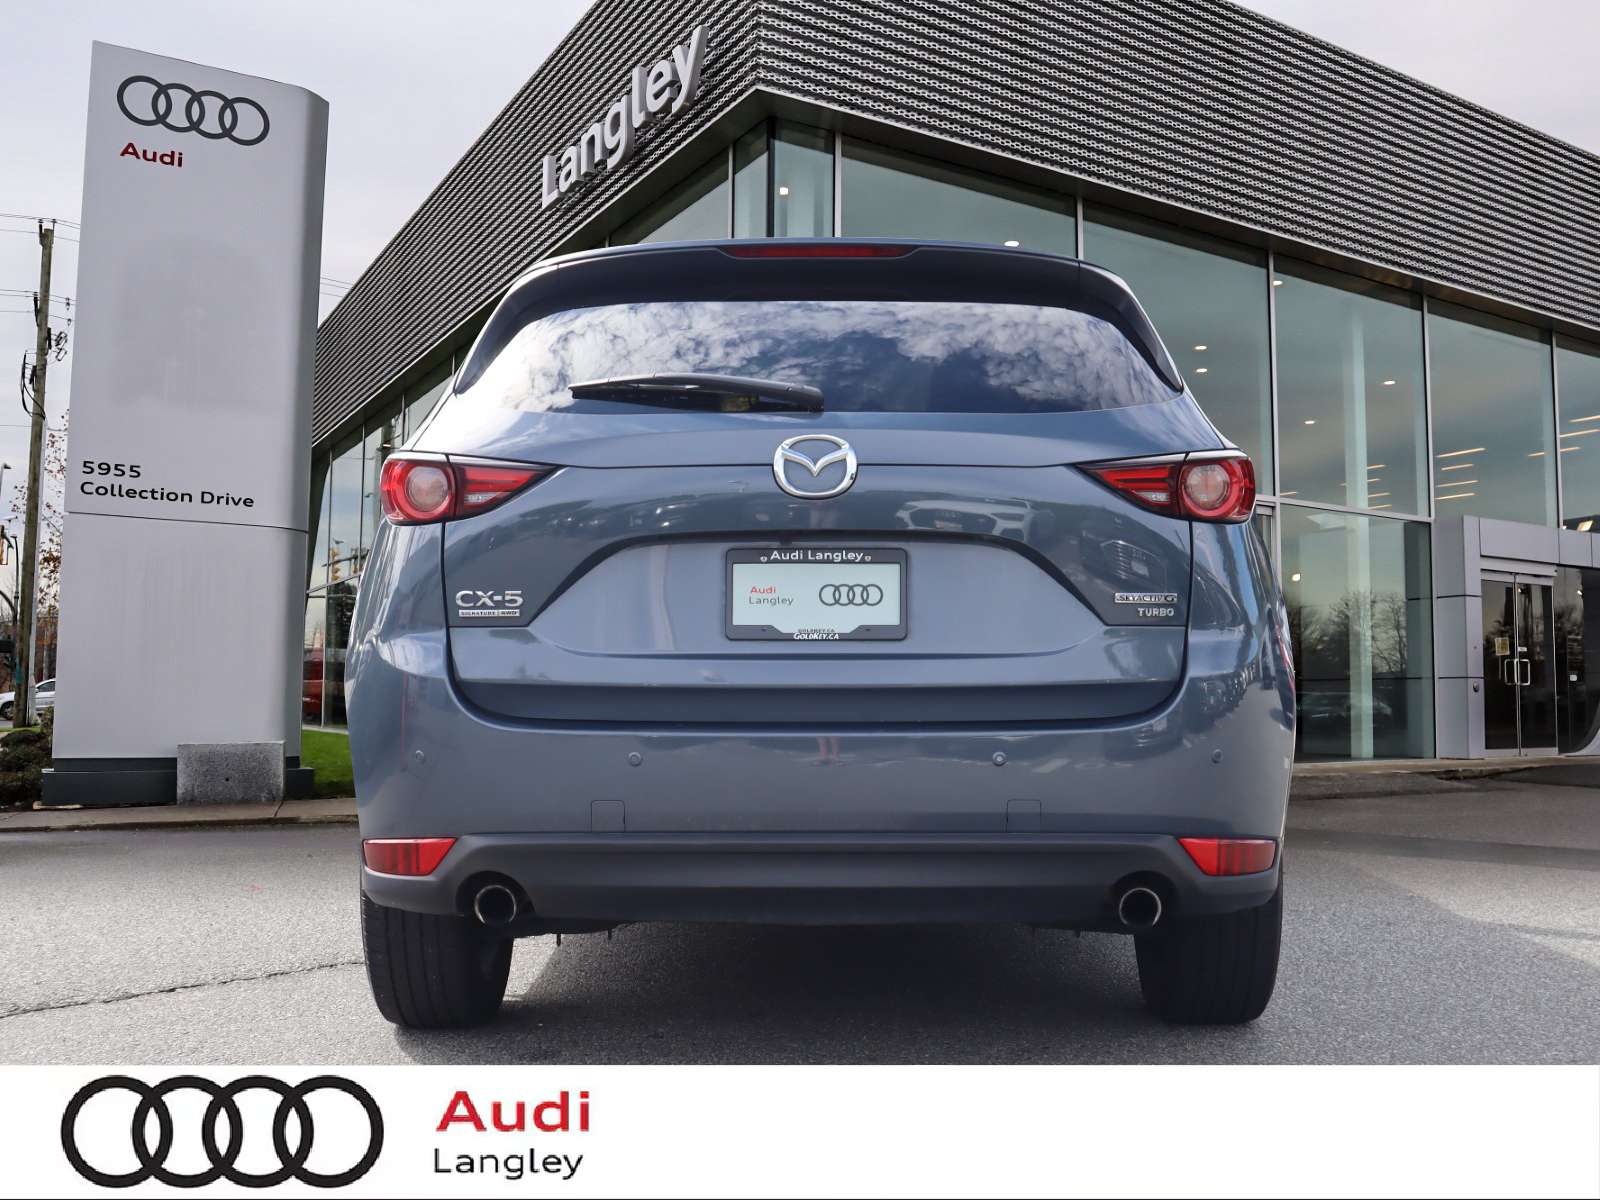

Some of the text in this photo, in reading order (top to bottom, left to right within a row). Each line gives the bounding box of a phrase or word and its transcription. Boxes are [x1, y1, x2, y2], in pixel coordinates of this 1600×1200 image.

[541, 24, 710, 210] Langley
[120, 142, 183, 168] Audi
[82, 460, 142, 479] 5955
[80, 481, 255, 508] Collection Drive
[769, 550, 864, 562] Audi Langley
[455, 590, 524, 607] CX-5
[750, 586, 777, 595] Audi
[748, 596, 794, 606] Langley
[1137, 607, 1175, 617] TURBO
